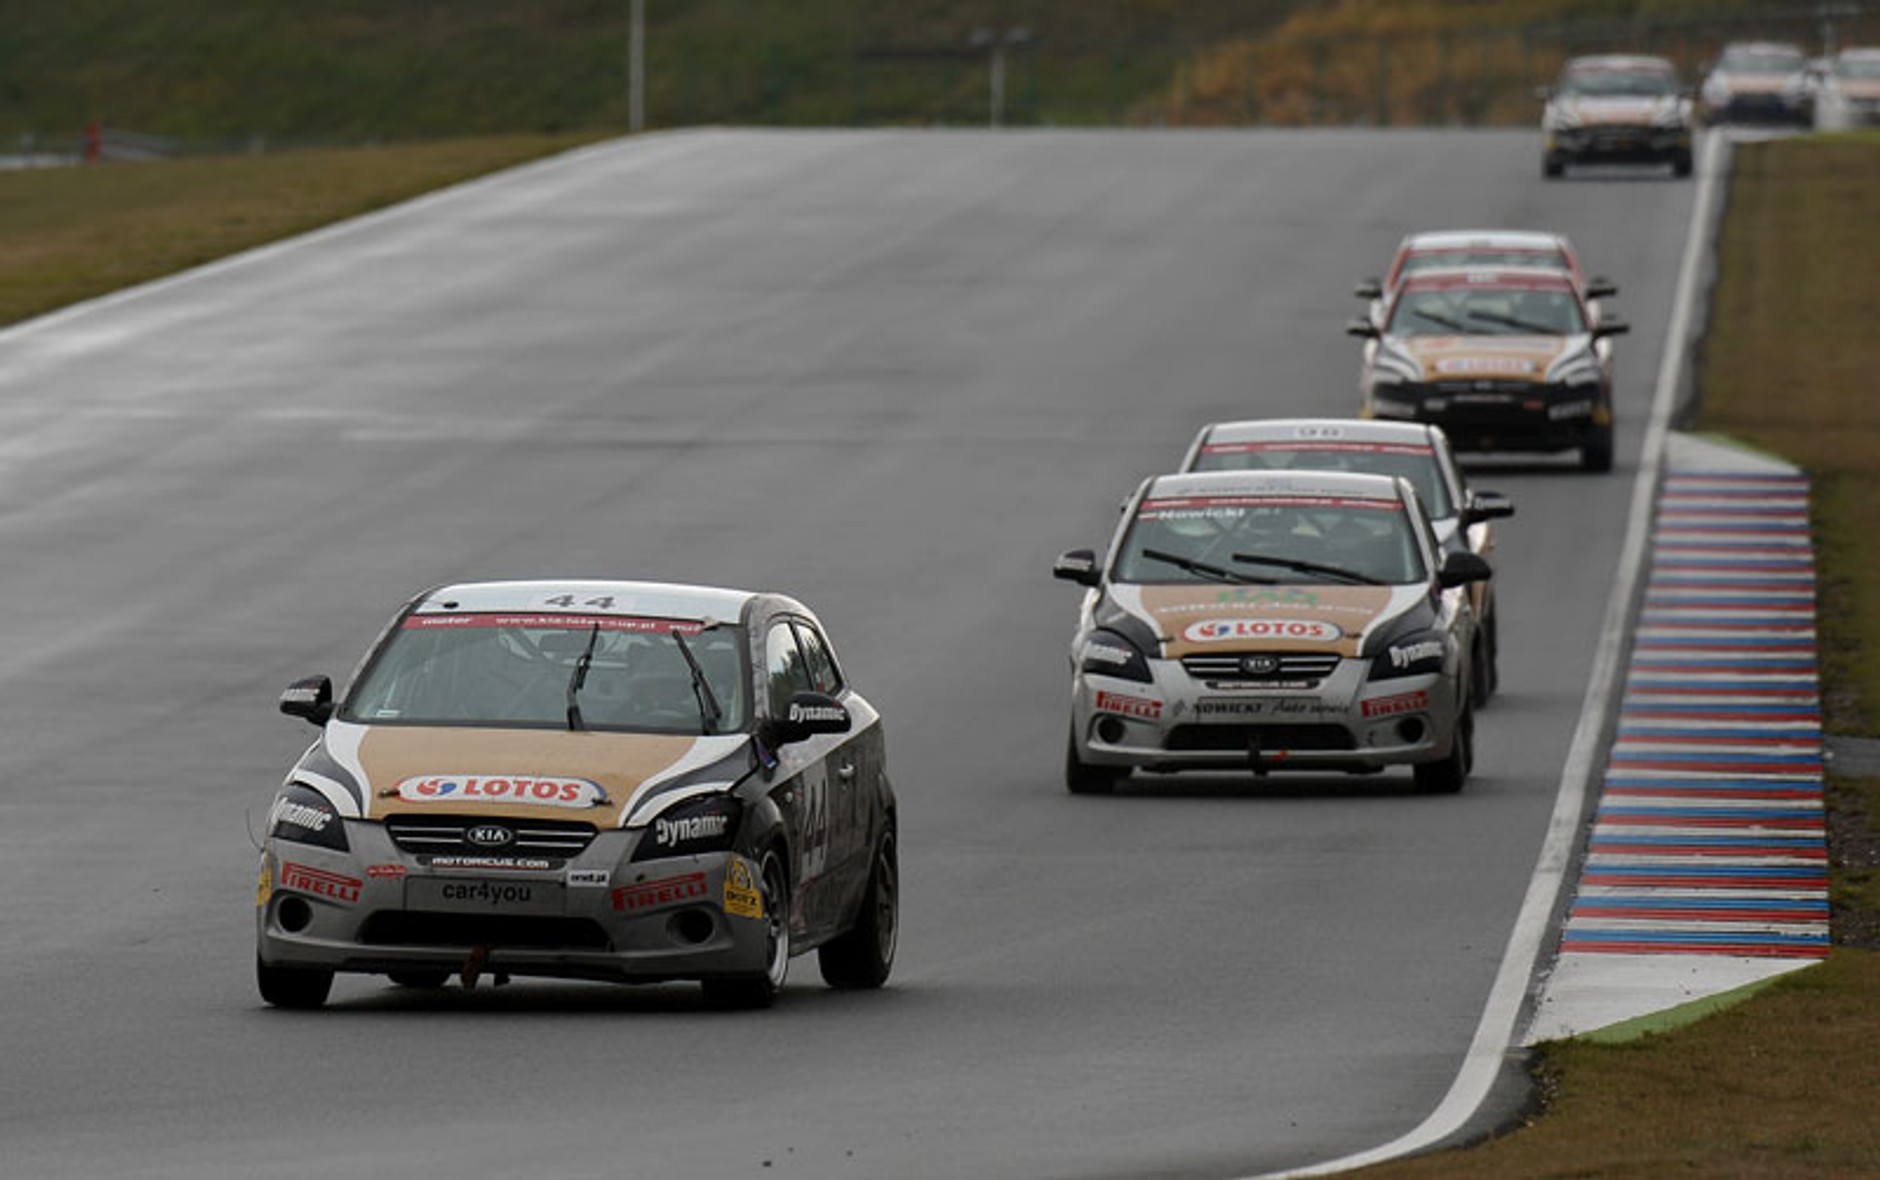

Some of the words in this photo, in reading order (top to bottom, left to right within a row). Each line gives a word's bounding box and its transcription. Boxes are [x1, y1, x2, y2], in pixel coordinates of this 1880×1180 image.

[544, 594, 617, 610] 44
[1235, 622, 1324, 637] LOTOS
[788, 702, 845, 724] Dynamic
[1095, 689, 1164, 719] PIRELLI
[1360, 689, 1430, 720] PIRELLI
[463, 778, 581, 802] LOTOS
[473, 827, 505, 842] KIA
[280, 861, 364, 903] PIRELLI
[441, 881, 532, 904] car4you
[611, 871, 709, 912] PIRELLI
